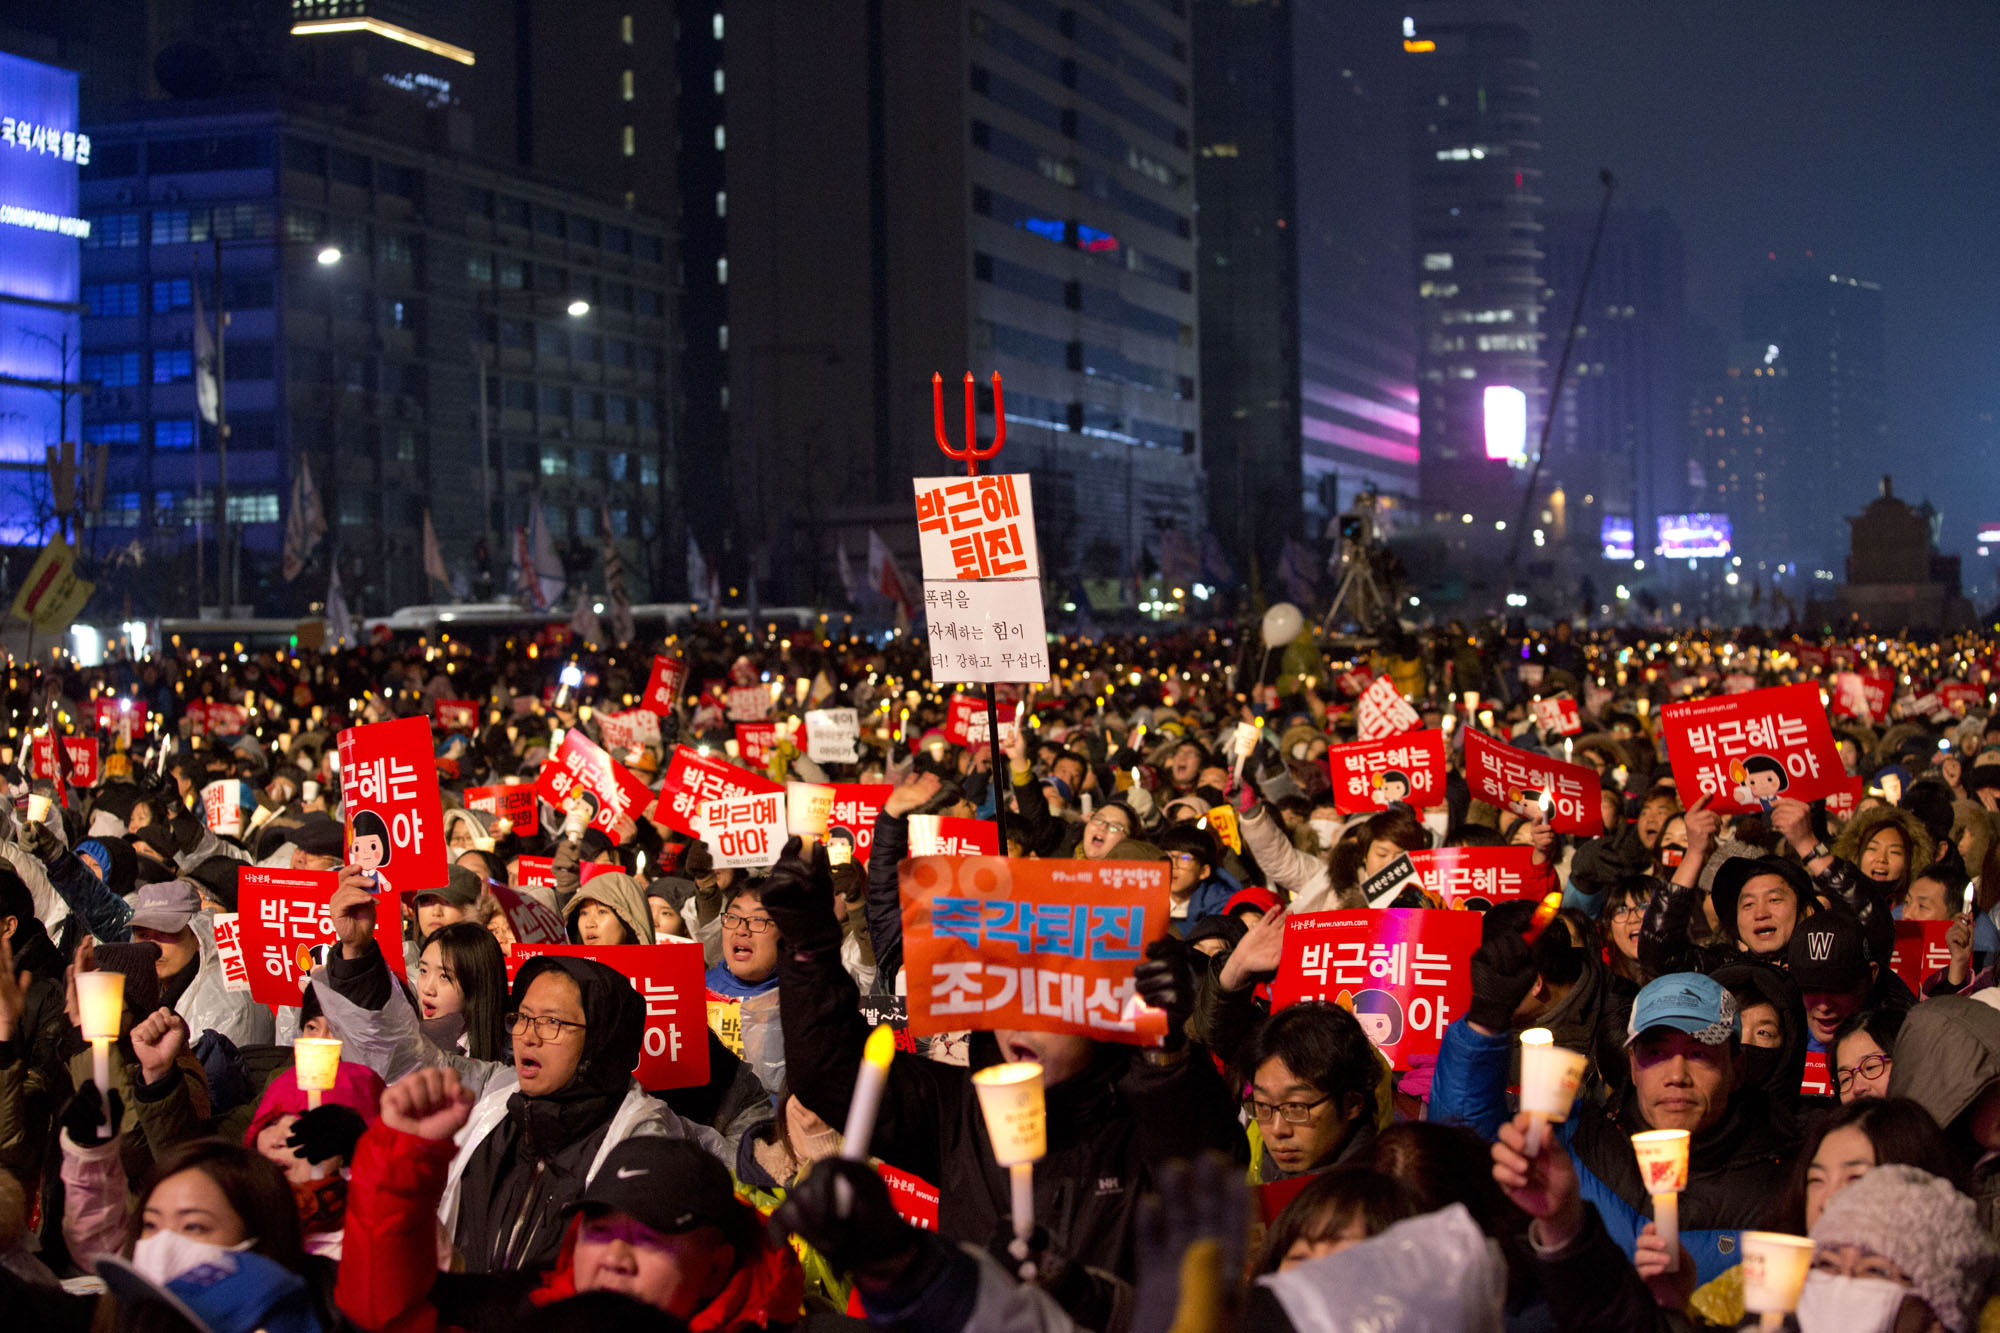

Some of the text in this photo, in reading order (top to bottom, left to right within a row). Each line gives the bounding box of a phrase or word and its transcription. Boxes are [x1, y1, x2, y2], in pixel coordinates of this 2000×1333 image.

[915, 474, 1020, 535] 박근혜
[950, 523, 1028, 579] 퇴진
[925, 589, 970, 609] 폭력을
[929, 620, 1024, 641] 자제하는 힘이
[956, 654, 992, 669] 강하고
[1001, 652, 1047, 669] 무섭다.
[1686, 713, 1808, 759] 박근혜는
[566, 749, 632, 809] 박근혜는
[1345, 745, 1430, 775] 박근혜는
[1480, 750, 1583, 797] 박근혜는
[1696, 748, 1819, 797] 하 야
[341, 757, 418, 807] 근혜는
[551, 770, 572, 798] 하
[1347, 769, 1433, 797] 하 야
[1482, 777, 1585, 823] 하 야
[671, 792, 695, 819] 하
[392, 809, 424, 854] 야
[718, 828, 769, 857] 하야
[1423, 866, 1522, 896] 박근혜는
[931, 896, 1146, 960] 즉각퇴진
[1316, 918, 1369, 929] www.nanum.com
[263, 944, 293, 982] 하
[1301, 942, 1452, 986] 박근혜는
[1807, 931, 1834, 961] W
[930, 961, 1137, 1033] 조기대선
[1408, 995, 1450, 1039] 야
[643, 1023, 683, 1063] 야
